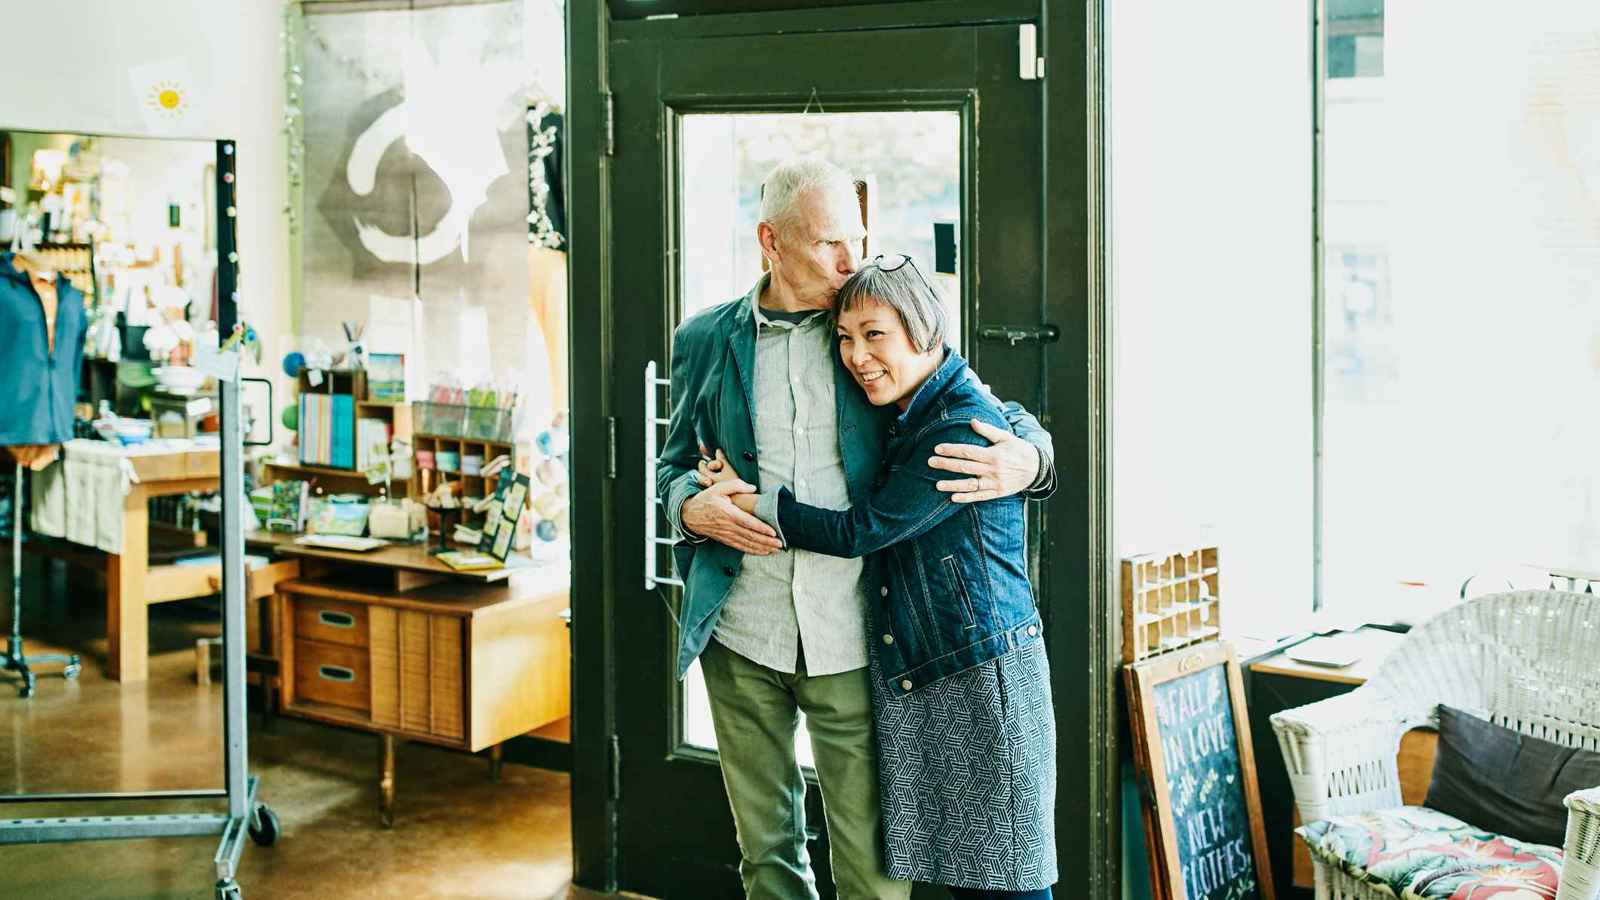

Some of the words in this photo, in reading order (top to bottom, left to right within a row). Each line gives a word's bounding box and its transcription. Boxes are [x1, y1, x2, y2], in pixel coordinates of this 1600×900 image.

[1168, 680, 1207, 725] FALL
[1162, 731, 1186, 774] IN
[1188, 711, 1229, 762] LOVE
[1187, 799, 1226, 855] NEW
